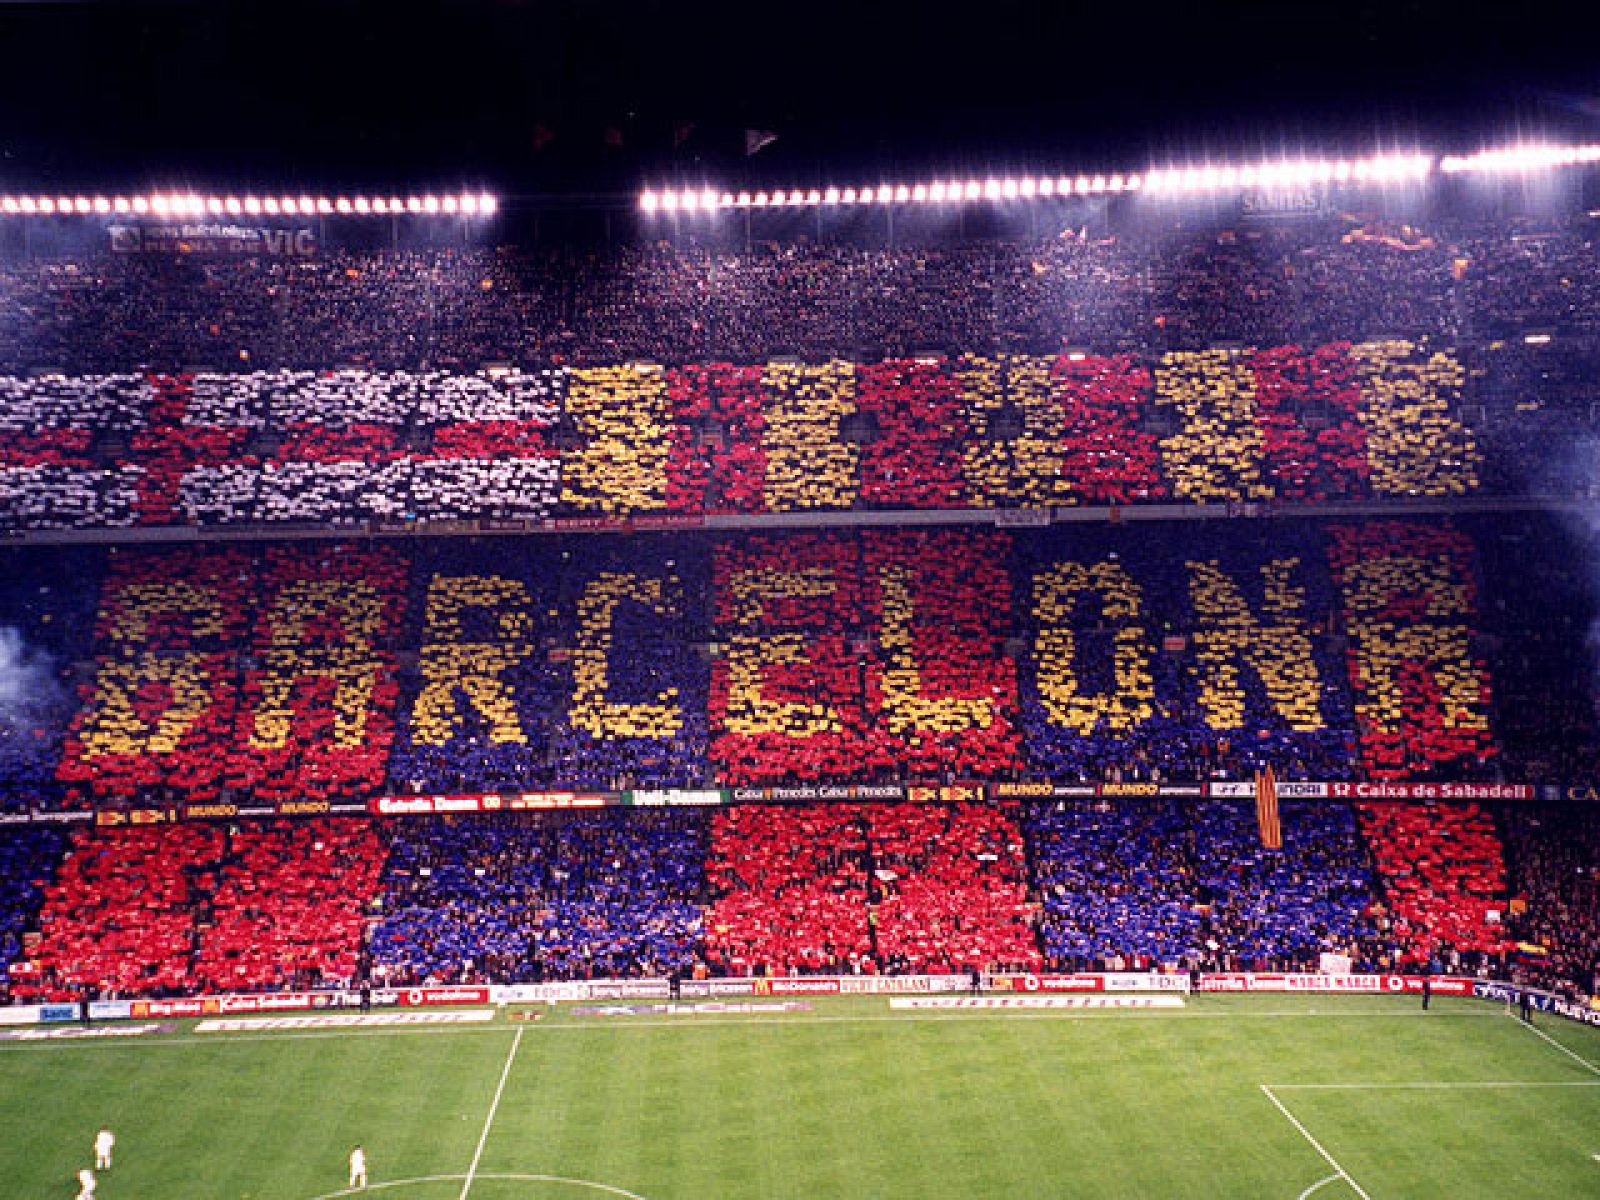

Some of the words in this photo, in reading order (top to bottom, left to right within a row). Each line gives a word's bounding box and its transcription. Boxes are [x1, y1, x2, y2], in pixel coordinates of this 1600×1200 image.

[262, 229, 315, 255] VIC
[80, 555, 1490, 758] BARCELONA
[999, 784, 1053, 797] MUNDO
[1103, 783, 1159, 796] MUNDO
[1357, 784, 1407, 798] Caixa
[1412, 784, 1437, 798] de
[1441, 784, 1526, 799] Sabadell
